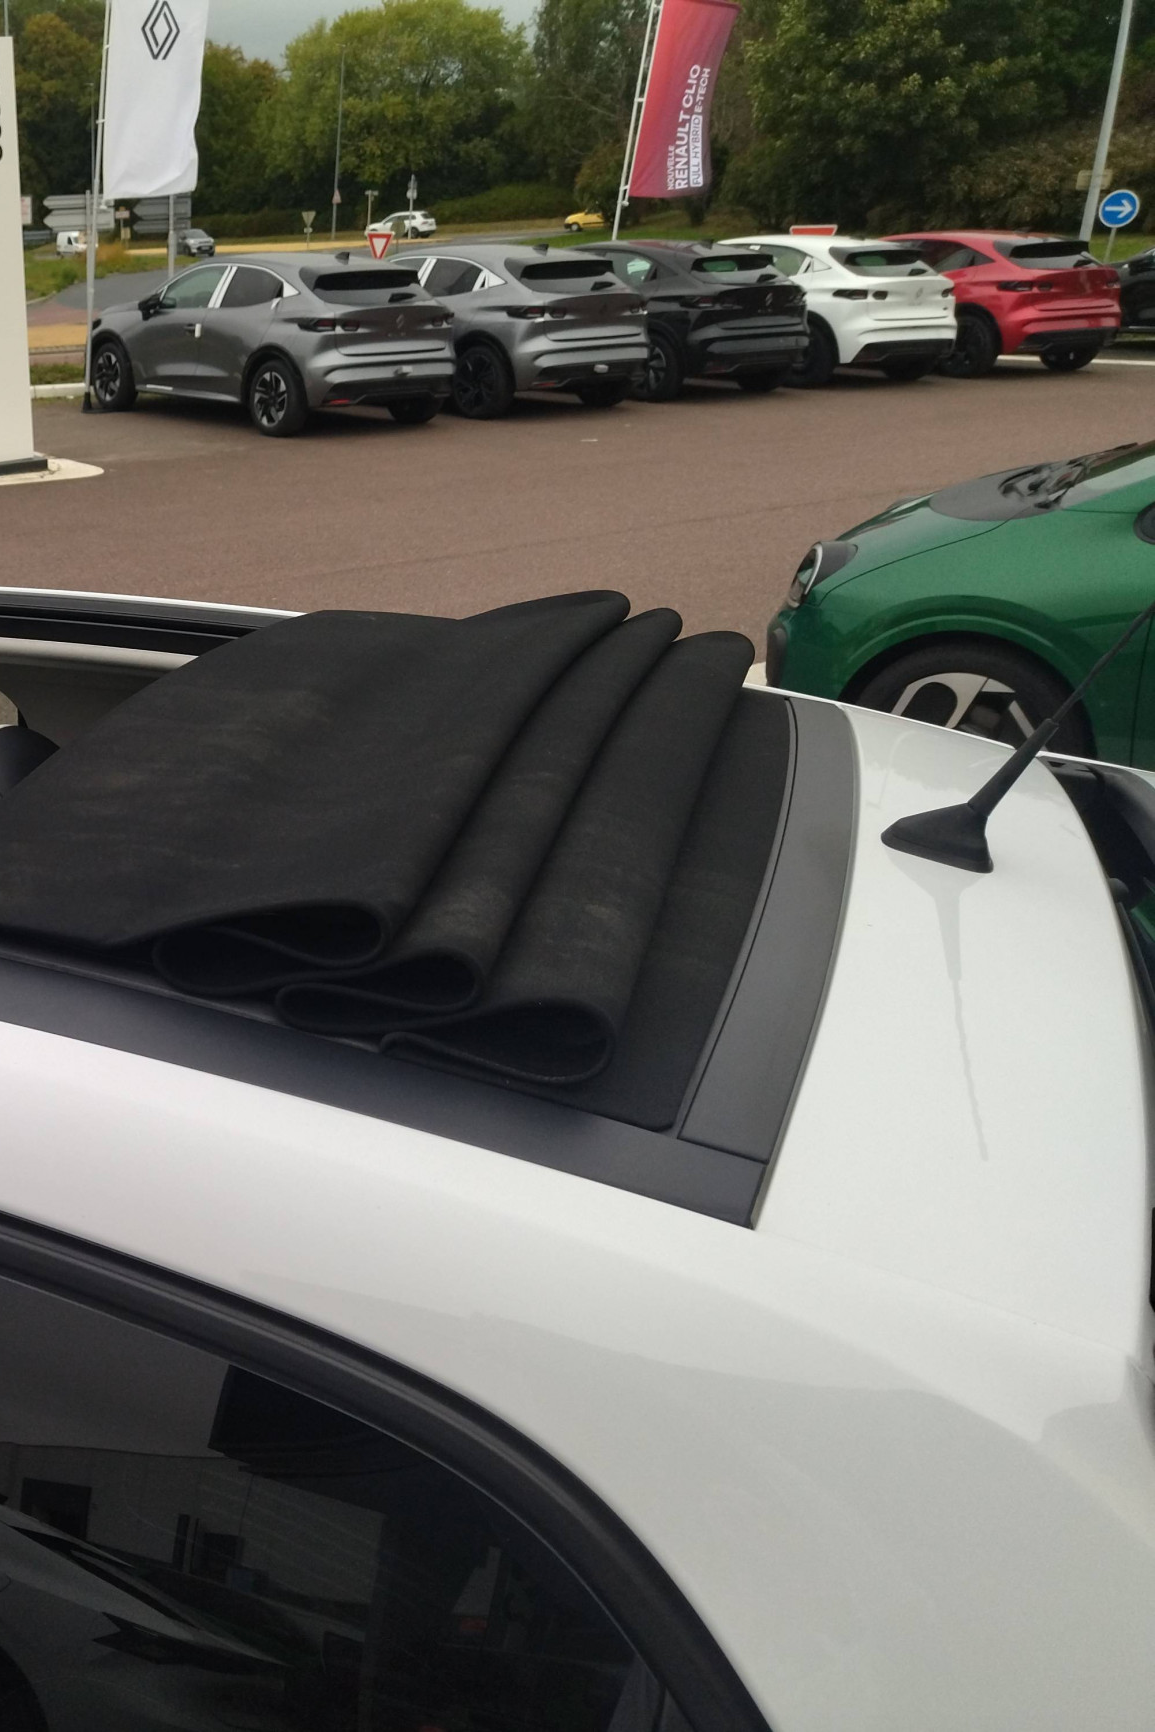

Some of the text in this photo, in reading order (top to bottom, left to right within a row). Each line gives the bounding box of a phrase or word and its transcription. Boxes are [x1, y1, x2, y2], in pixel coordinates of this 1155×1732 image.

[667, 145, 675, 190] NOUVELLE
[675, 64, 701, 189] RENAULT CLIO
[691, 68, 711, 186] FULL HYBRID E-TECH
